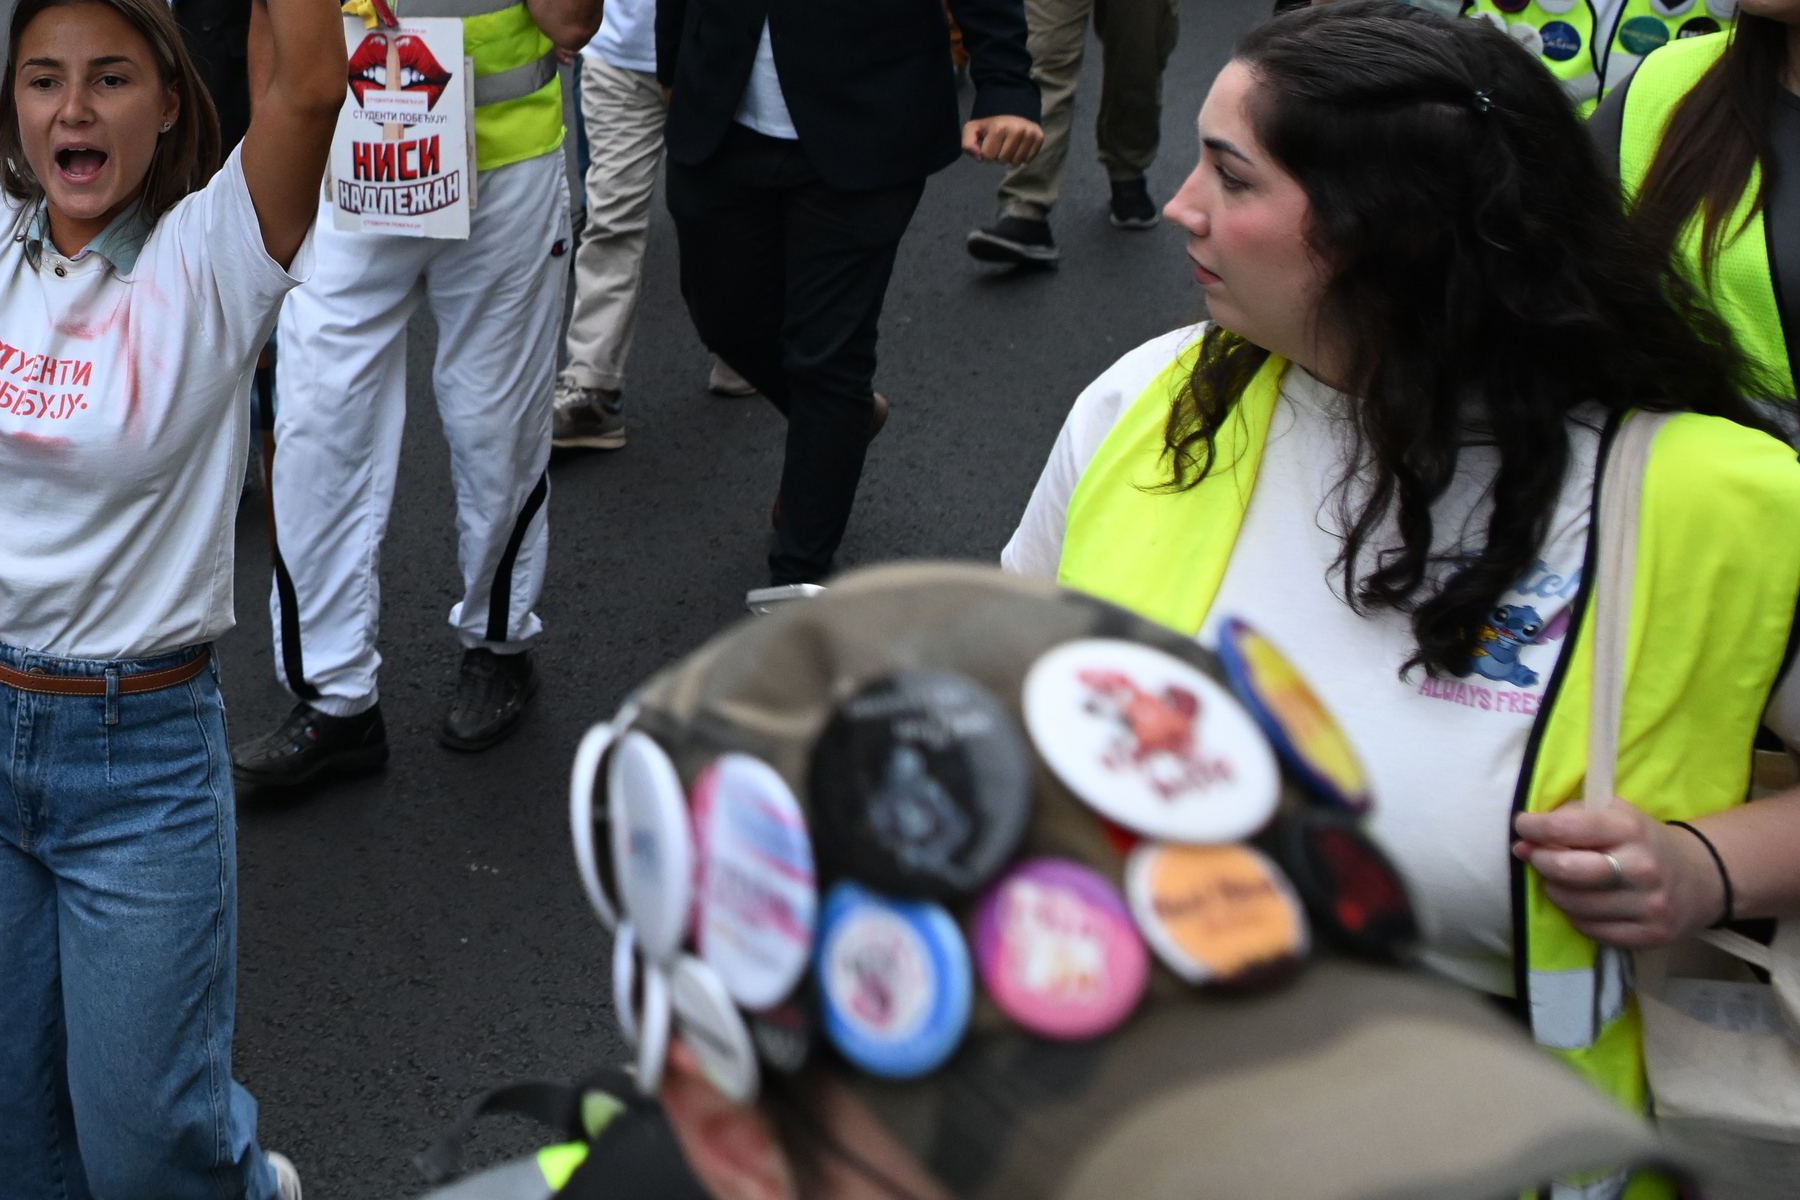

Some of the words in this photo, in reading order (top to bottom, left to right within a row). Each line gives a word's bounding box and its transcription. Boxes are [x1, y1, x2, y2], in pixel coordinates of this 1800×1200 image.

[353, 109, 397, 121] СТУДЕНТИ
[399, 112, 448, 124] ПОБЕЂУЈУ!
[352, 134, 441, 183] НИСИ
[338, 169, 460, 217] НАДЛЕЖАН
[1417, 675, 1493, 712] ALWAYS
